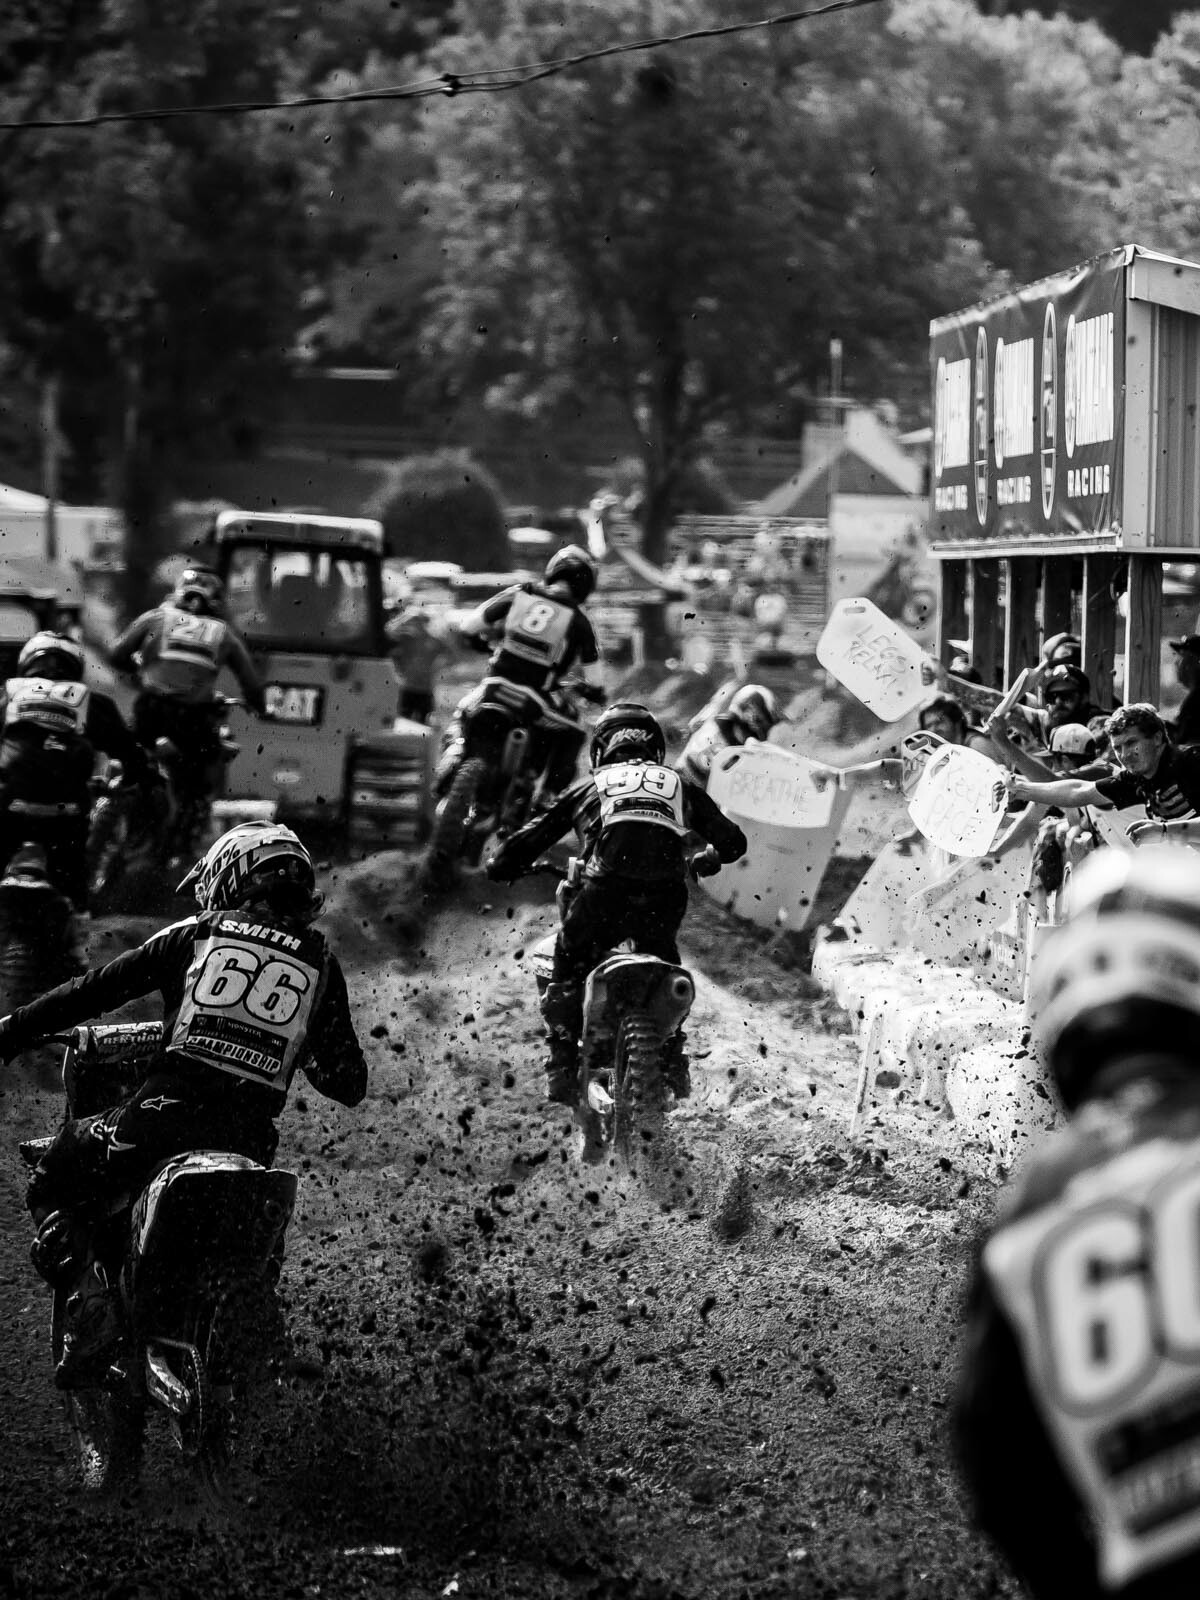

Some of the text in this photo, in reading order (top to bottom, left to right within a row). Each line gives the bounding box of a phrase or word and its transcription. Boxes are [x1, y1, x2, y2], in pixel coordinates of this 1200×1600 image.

[1067, 464, 1110, 499] RACING
[520, 601, 560, 636] 8
[265, 685, 319, 722] CAT
[604, 766, 679, 800] 99
[219, 919, 301, 951] SMITH
[193, 945, 310, 1026] 66
